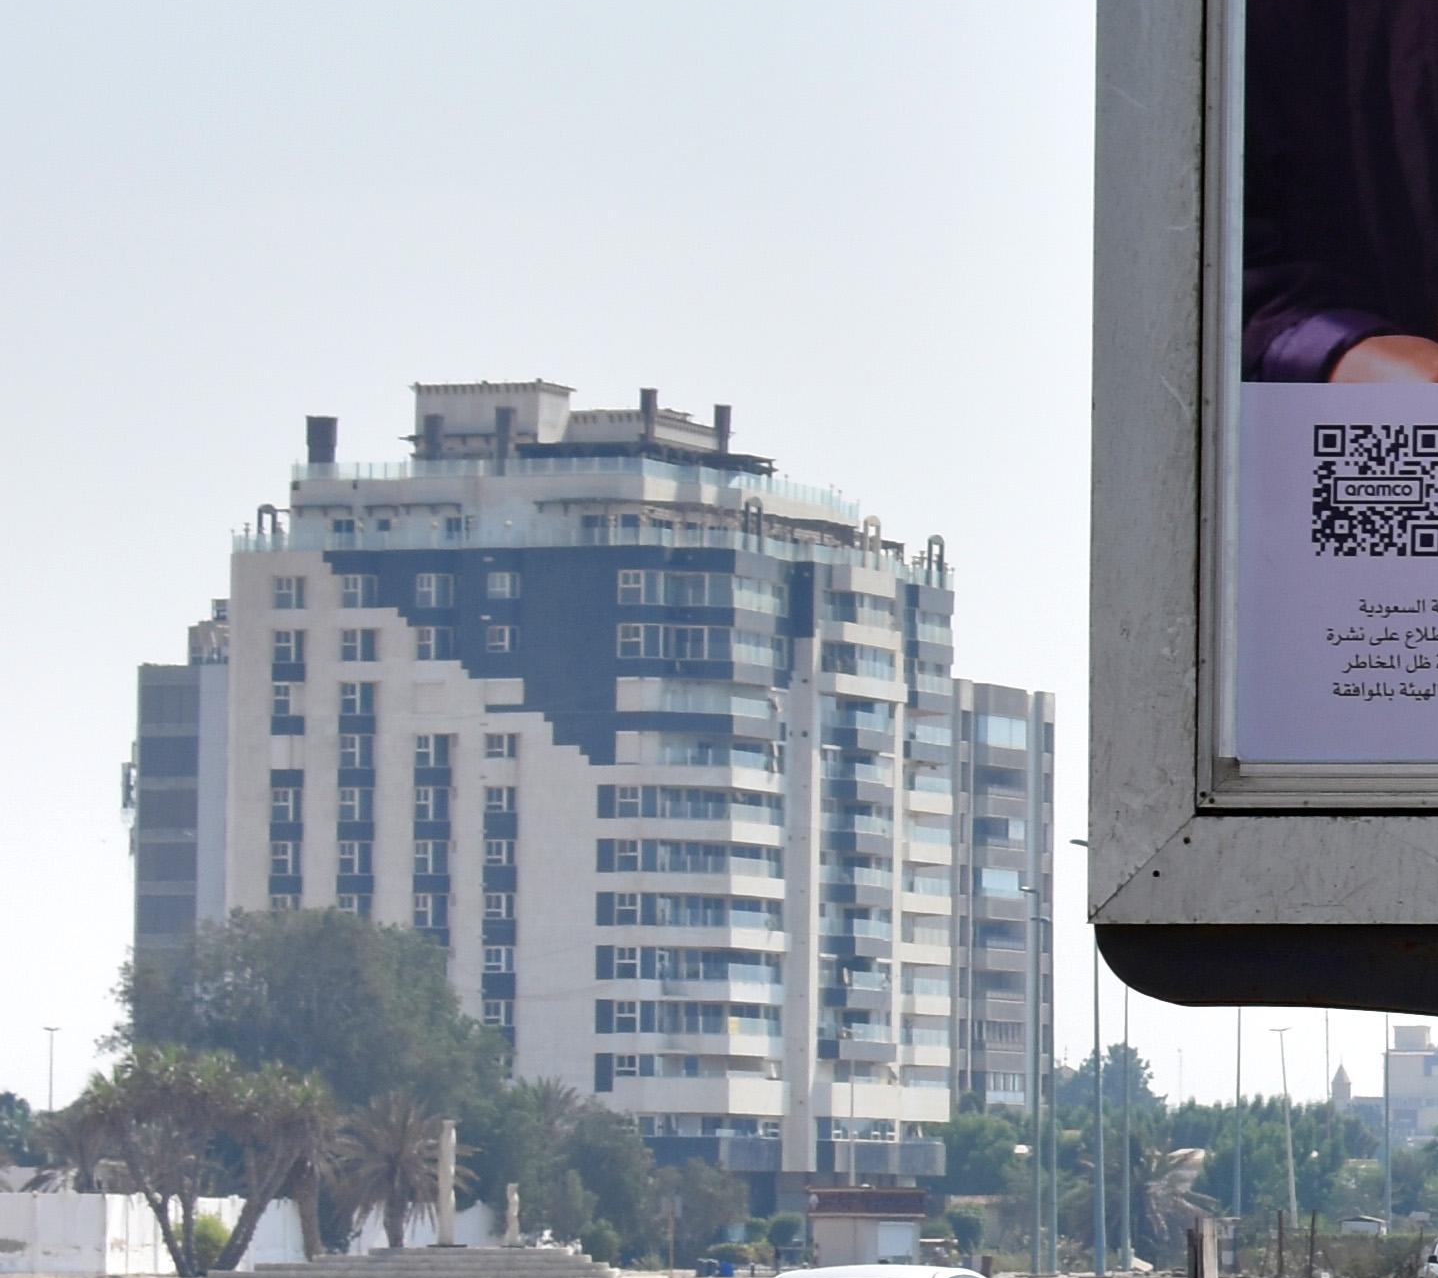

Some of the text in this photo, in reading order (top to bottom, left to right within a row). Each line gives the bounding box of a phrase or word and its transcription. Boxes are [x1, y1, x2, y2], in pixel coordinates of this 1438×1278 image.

[1344, 482, 1413, 497] aramco
[1358, 598, 1426, 619] السعودية
[1341, 653, 1402, 674] المخاطر
[1404, 653, 1432, 674] ظل
[1332, 681, 1395, 702] بالموافقة
